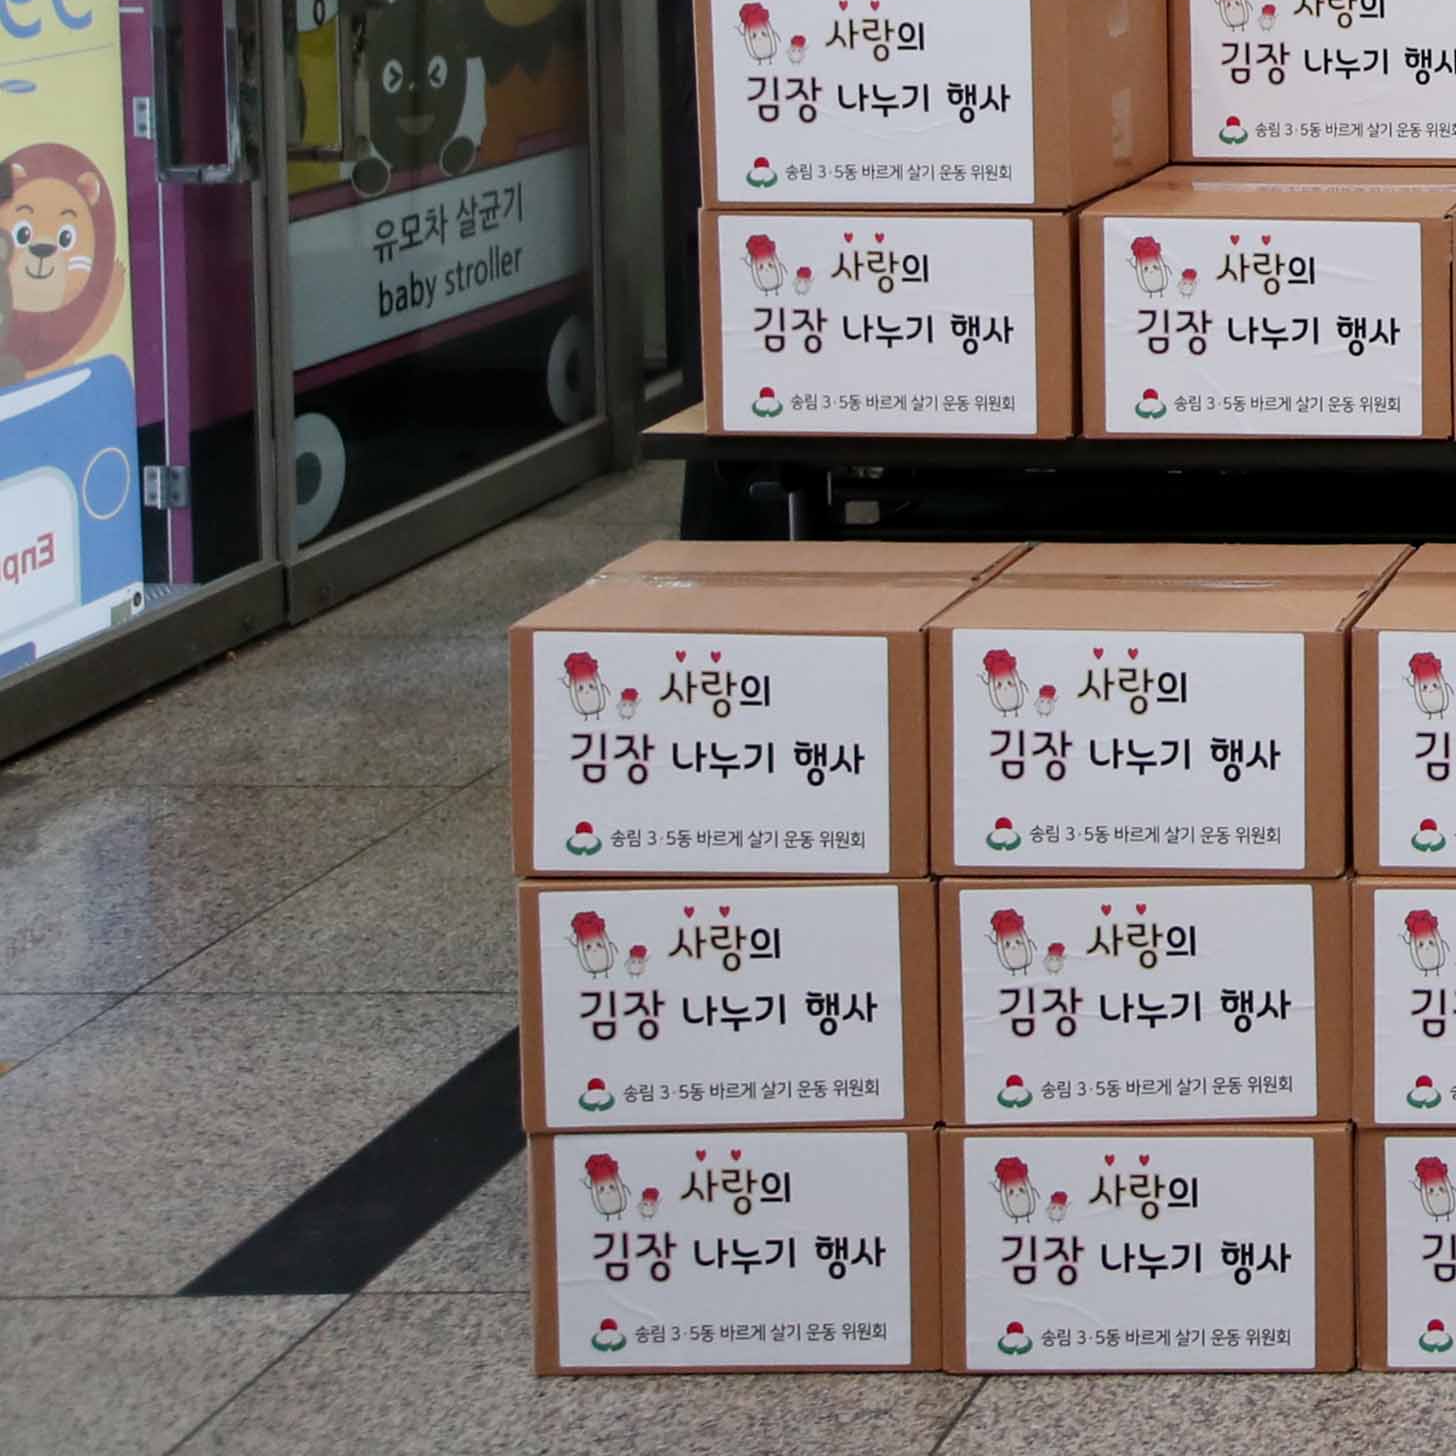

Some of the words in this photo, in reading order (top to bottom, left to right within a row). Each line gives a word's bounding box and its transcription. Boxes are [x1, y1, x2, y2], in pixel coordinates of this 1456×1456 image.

[825, 18, 925, 62] 사랑의
[747, 76, 823, 124] 김장
[838, 83, 929, 118] 나누기
[946, 82, 1011, 124] 행사
[785, 163, 812, 181] 송림
[861, 164, 903, 180] 바르게
[907, 164, 934, 181] 살기
[939, 164, 967, 181] 운동
[970, 164, 1011, 181] 위원회
[373, 203, 448, 264] 유모차
[456, 182, 523, 239] 살균기
[379, 271, 437, 318] baby
[445, 245, 523, 296] stroller
[659, 670, 770, 718] 사랑의
[571, 732, 655, 785] 김장
[672, 741, 774, 779] 나누기
[793, 740, 865, 787] 행사
[610, 828, 640, 847] 송림
[696, 829, 742, 848] 바르게
[747, 830, 778, 848] 살기
[783, 830, 814, 849] 운동
[819, 830, 864, 849] 위원회
[680, 1169, 791, 1216] 사랑의
[593, 1232, 677, 1282] 김장
[694, 1237, 795, 1275] 나누기
[814, 1235, 886, 1280] 행사
[634, 1324, 665, 1343] 송림
[720, 1324, 765, 1342] 바르게
[770, 1323, 800, 1341] 살기
[806, 1323, 836, 1341] 운동
[841, 1322, 886, 1340] 위원회
